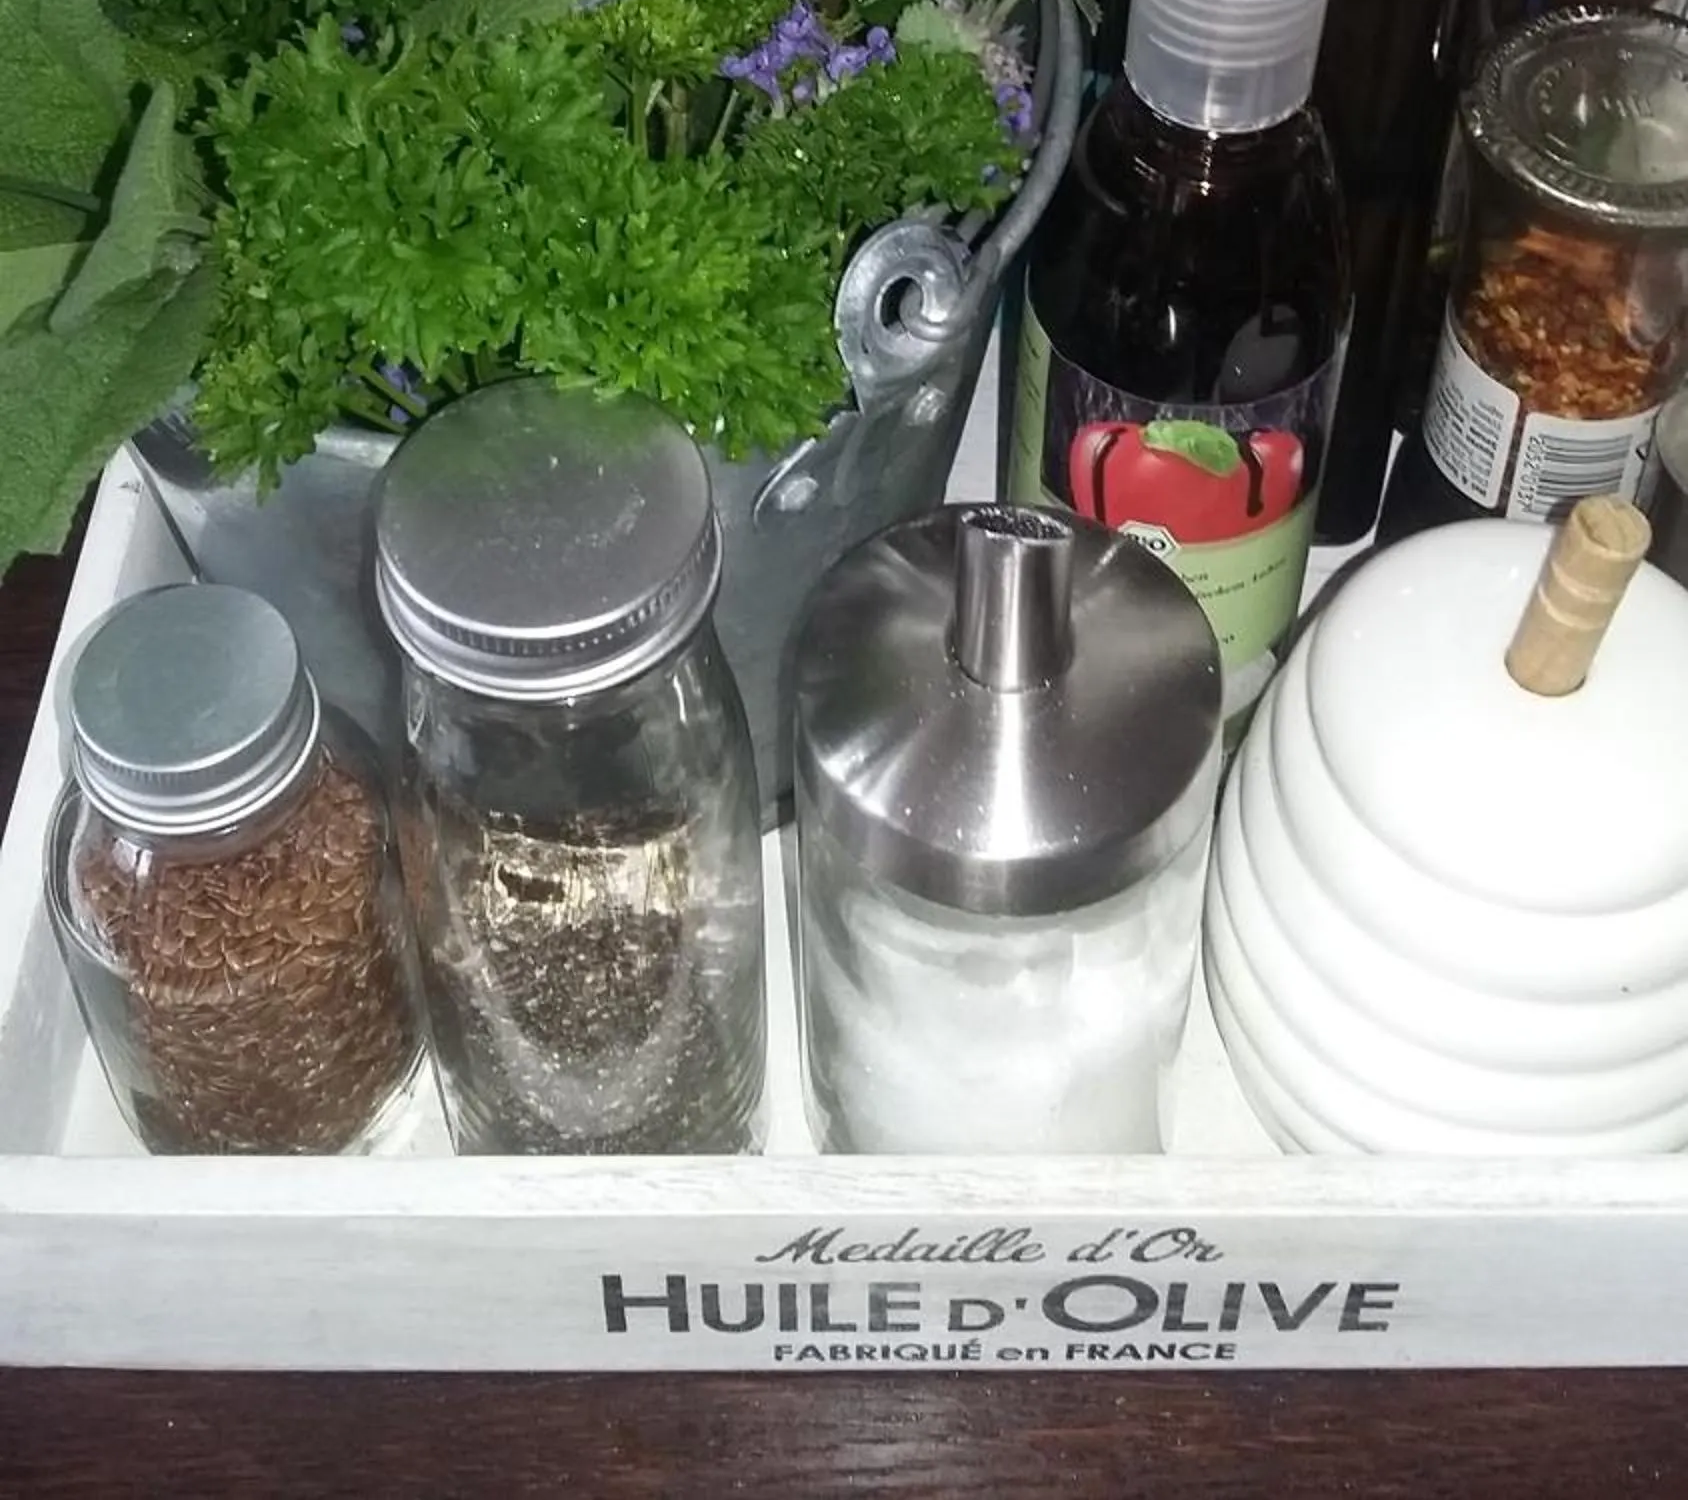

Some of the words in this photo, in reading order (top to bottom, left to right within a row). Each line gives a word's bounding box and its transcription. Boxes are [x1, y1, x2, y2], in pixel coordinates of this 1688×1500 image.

[755, 1227, 1045, 1265] Medaille
[1067, 1227, 1224, 1263] d'Or
[601, 1274, 921, 1332] HUILE
[773, 1339, 982, 1362] FABRIQUÉ
[996, 1347, 1050, 1361] en
[1066, 1343, 1237, 1361] FRANCE
